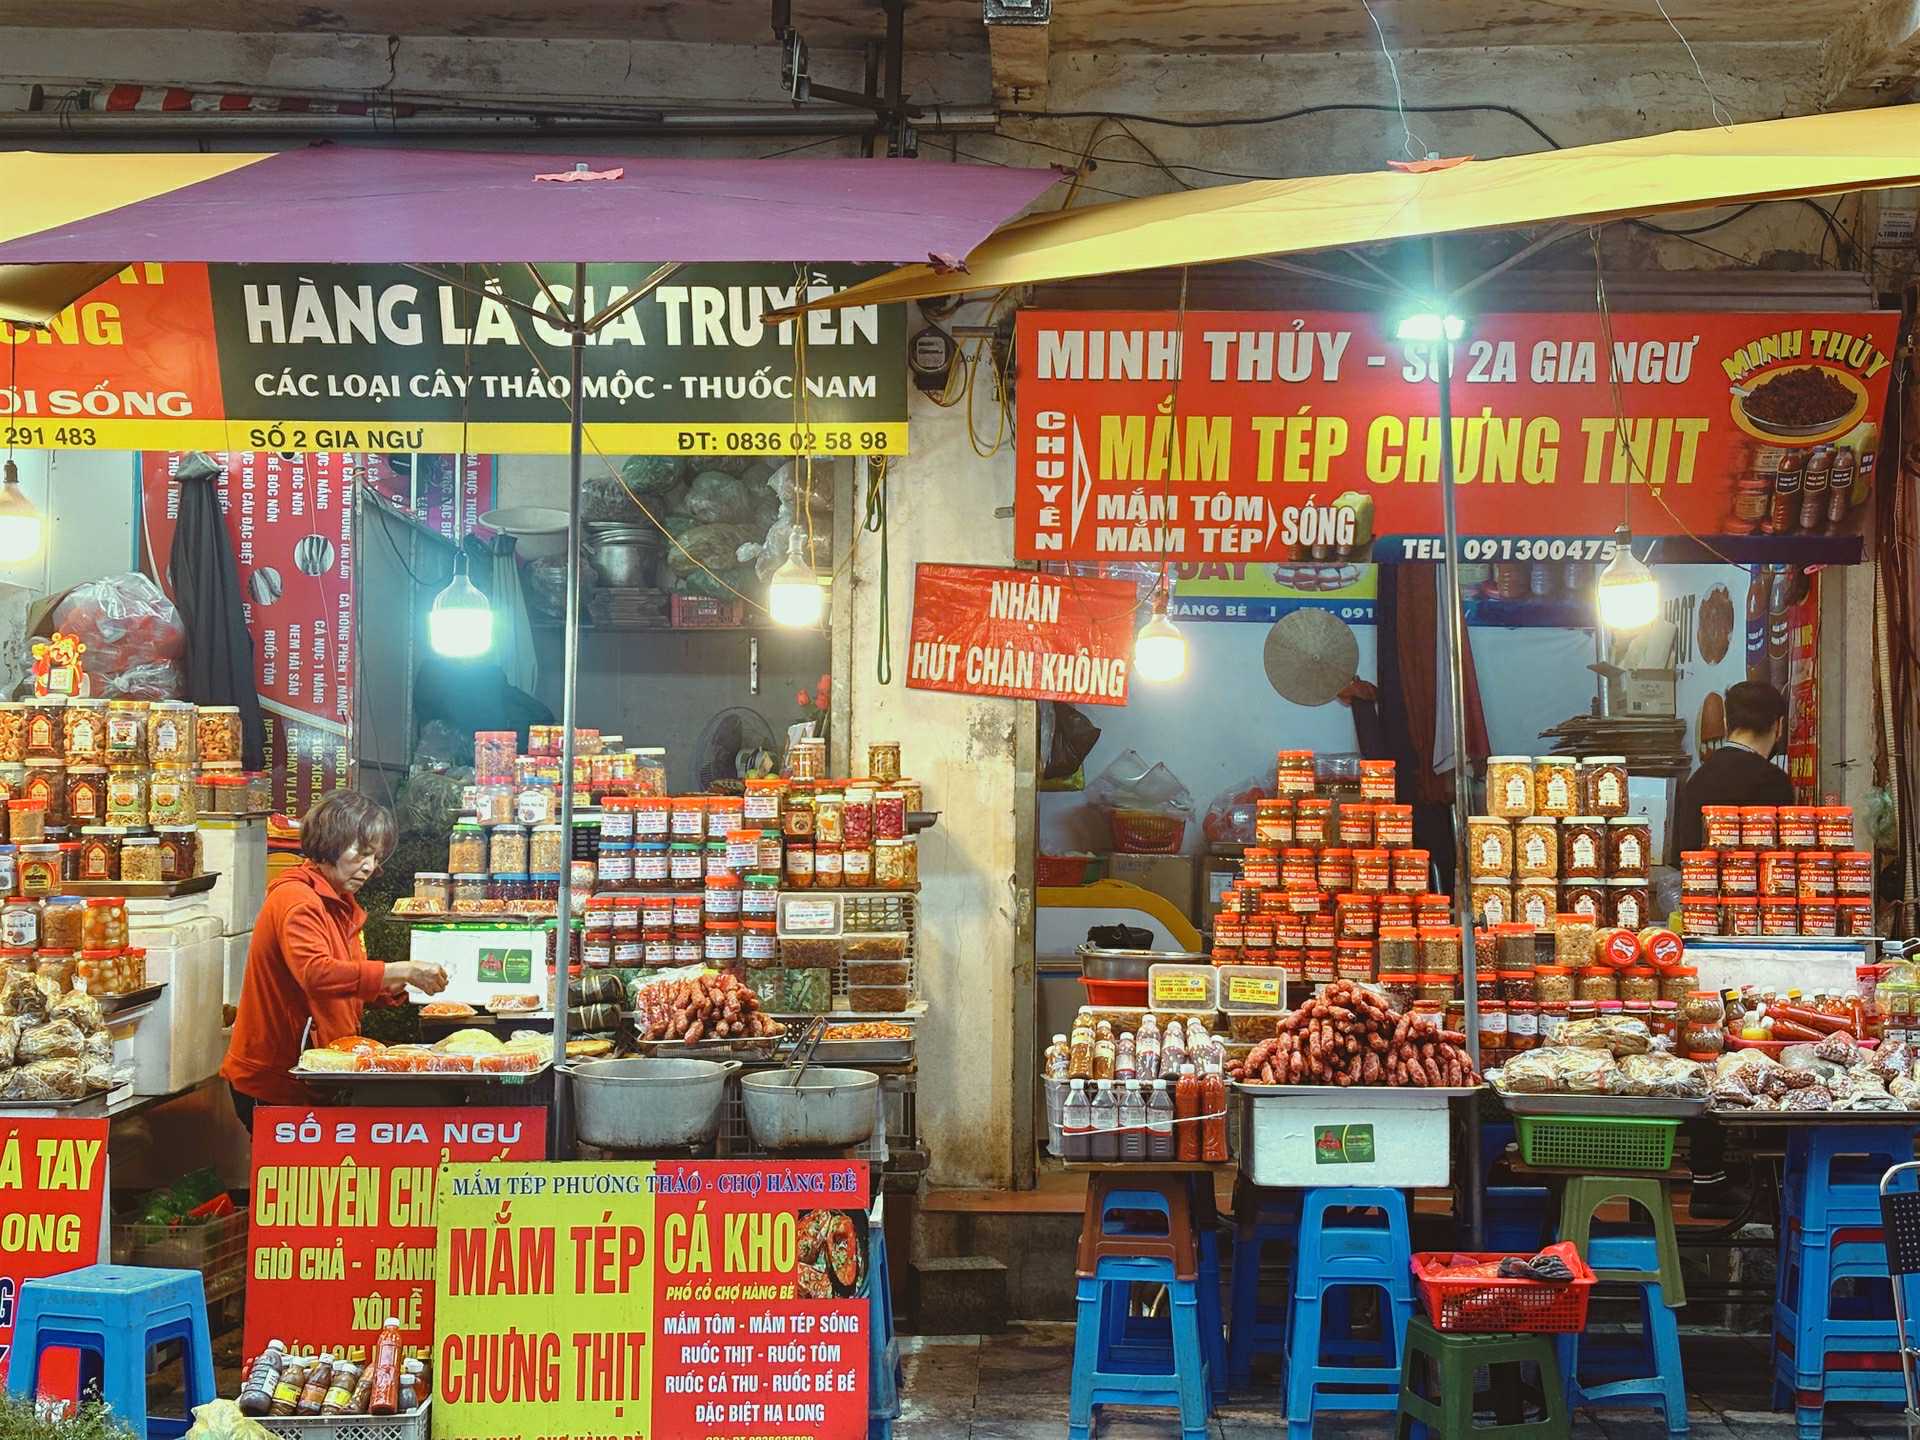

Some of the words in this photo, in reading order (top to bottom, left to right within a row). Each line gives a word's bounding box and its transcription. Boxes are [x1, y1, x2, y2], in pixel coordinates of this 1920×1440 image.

[243, 277, 423, 345] HÀNG
[531, 285, 646, 346] GIA
[1036, 330, 1183, 382] MINH
[1203, 319, 1351, 383] THỦY
[1466, 341, 1517, 384] 2A
[1530, 341, 1597, 384] GIA
[1609, 335, 1700, 384] NGƯ
[1720, 329, 1804, 383] MINH
[48, 379, 192, 416] SỐNG
[254, 367, 319, 397] CÁC
[328, 374, 400, 403] LOẠI
[409, 368, 471, 397] CÂY
[481, 367, 570, 399] THẢO
[582, 369, 655, 405] MỘC
[679, 366, 793, 400] THUỐC
[804, 375, 877, 398] NAM
[5, 427, 44, 445] 291
[55, 428, 96, 445] 483
[249, 423, 286, 448] SỐ
[293, 429, 307, 447] 2
[315, 430, 359, 448] GIA
[367, 428, 424, 448] NGƯ
[678, 432, 717, 450] ĐT:
[726, 432, 782, 450] 0836
[790, 432, 817, 450] 02
[825, 432, 851, 450] 58
[860, 432, 888, 450] 98
[1251, 406, 1349, 483] TÉP
[1365, 405, 1561, 485] CHƯNG
[1190, 491, 1264, 522] TÔM
[1281, 495, 1355, 546] SỐNG
[1199, 524, 1263, 553] TÉP
[989, 576, 1061, 631] NHẬN
[1341, 607, 1374, 619] 091
[264, 630, 279, 659] RUỐC
[289, 624, 300, 647] NEM
[264, 661, 276, 685] TÔM
[911, 635, 961, 681] HÚT
[966, 641, 1034, 689] CHÂN
[1041, 647, 1126, 697] KHÔNG
[275, 1112, 321, 1143] SỐ
[336, 1123, 356, 1143] 2
[371, 1123, 429, 1143] GIA
[443, 1121, 523, 1143] NGƯ
[37, 1139, 101, 1190] TAY
[255, 1156, 380, 1227] CHUYÊN
[453, 1169, 501, 1196] MẮM
[507, 1171, 546, 1195] TÉP
[552, 1173, 640, 1194] PHƯƠNG
[718, 1172, 762, 1198] CHỢ
[766, 1168, 824, 1192] HÀNG
[830, 1168, 857, 1192] BÈ
[449, 1200, 555, 1296] MẮM
[570, 1210, 646, 1294] TÉP
[664, 1200, 712, 1274] CÁ
[724, 1211, 796, 1273] KHO
[254, 1242, 293, 1280] GIÒ
[300, 1237, 345, 1280] CHẢ
[666, 1280, 692, 1300] PHỐ
[695, 1278, 712, 1300] CỔ
[714, 1284, 741, 1303] CHỢ
[742, 1283, 777, 1300] HÀNG
[664, 1311, 699, 1335] MẮM
[704, 1313, 735, 1333] TÔM
[749, 1310, 785, 1333] MẮM
[790, 1312, 815, 1332] TÉP
[819, 1310, 859, 1333] SỐNG
[681, 1340, 719, 1363] RUỐC
[724, 1346, 754, 1367] THỊT
[767, 1339, 806, 1363] RUỐC
[810, 1344, 841, 1362] TÔM
[441, 1326, 561, 1404] CHƯNG
[572, 1332, 646, 1417] THỊT
[665, 1370, 704, 1393] RUỐC
[708, 1372, 728, 1393] CÁ
[732, 1376, 758, 1392] THU
[772, 1369, 811, 1392] RUỐC
[695, 1401, 724, 1426] ĐẶC
[728, 1401, 760, 1426] BIỆT
[764, 1405, 783, 1426] HẠ
[787, 1404, 825, 1427] LONG
